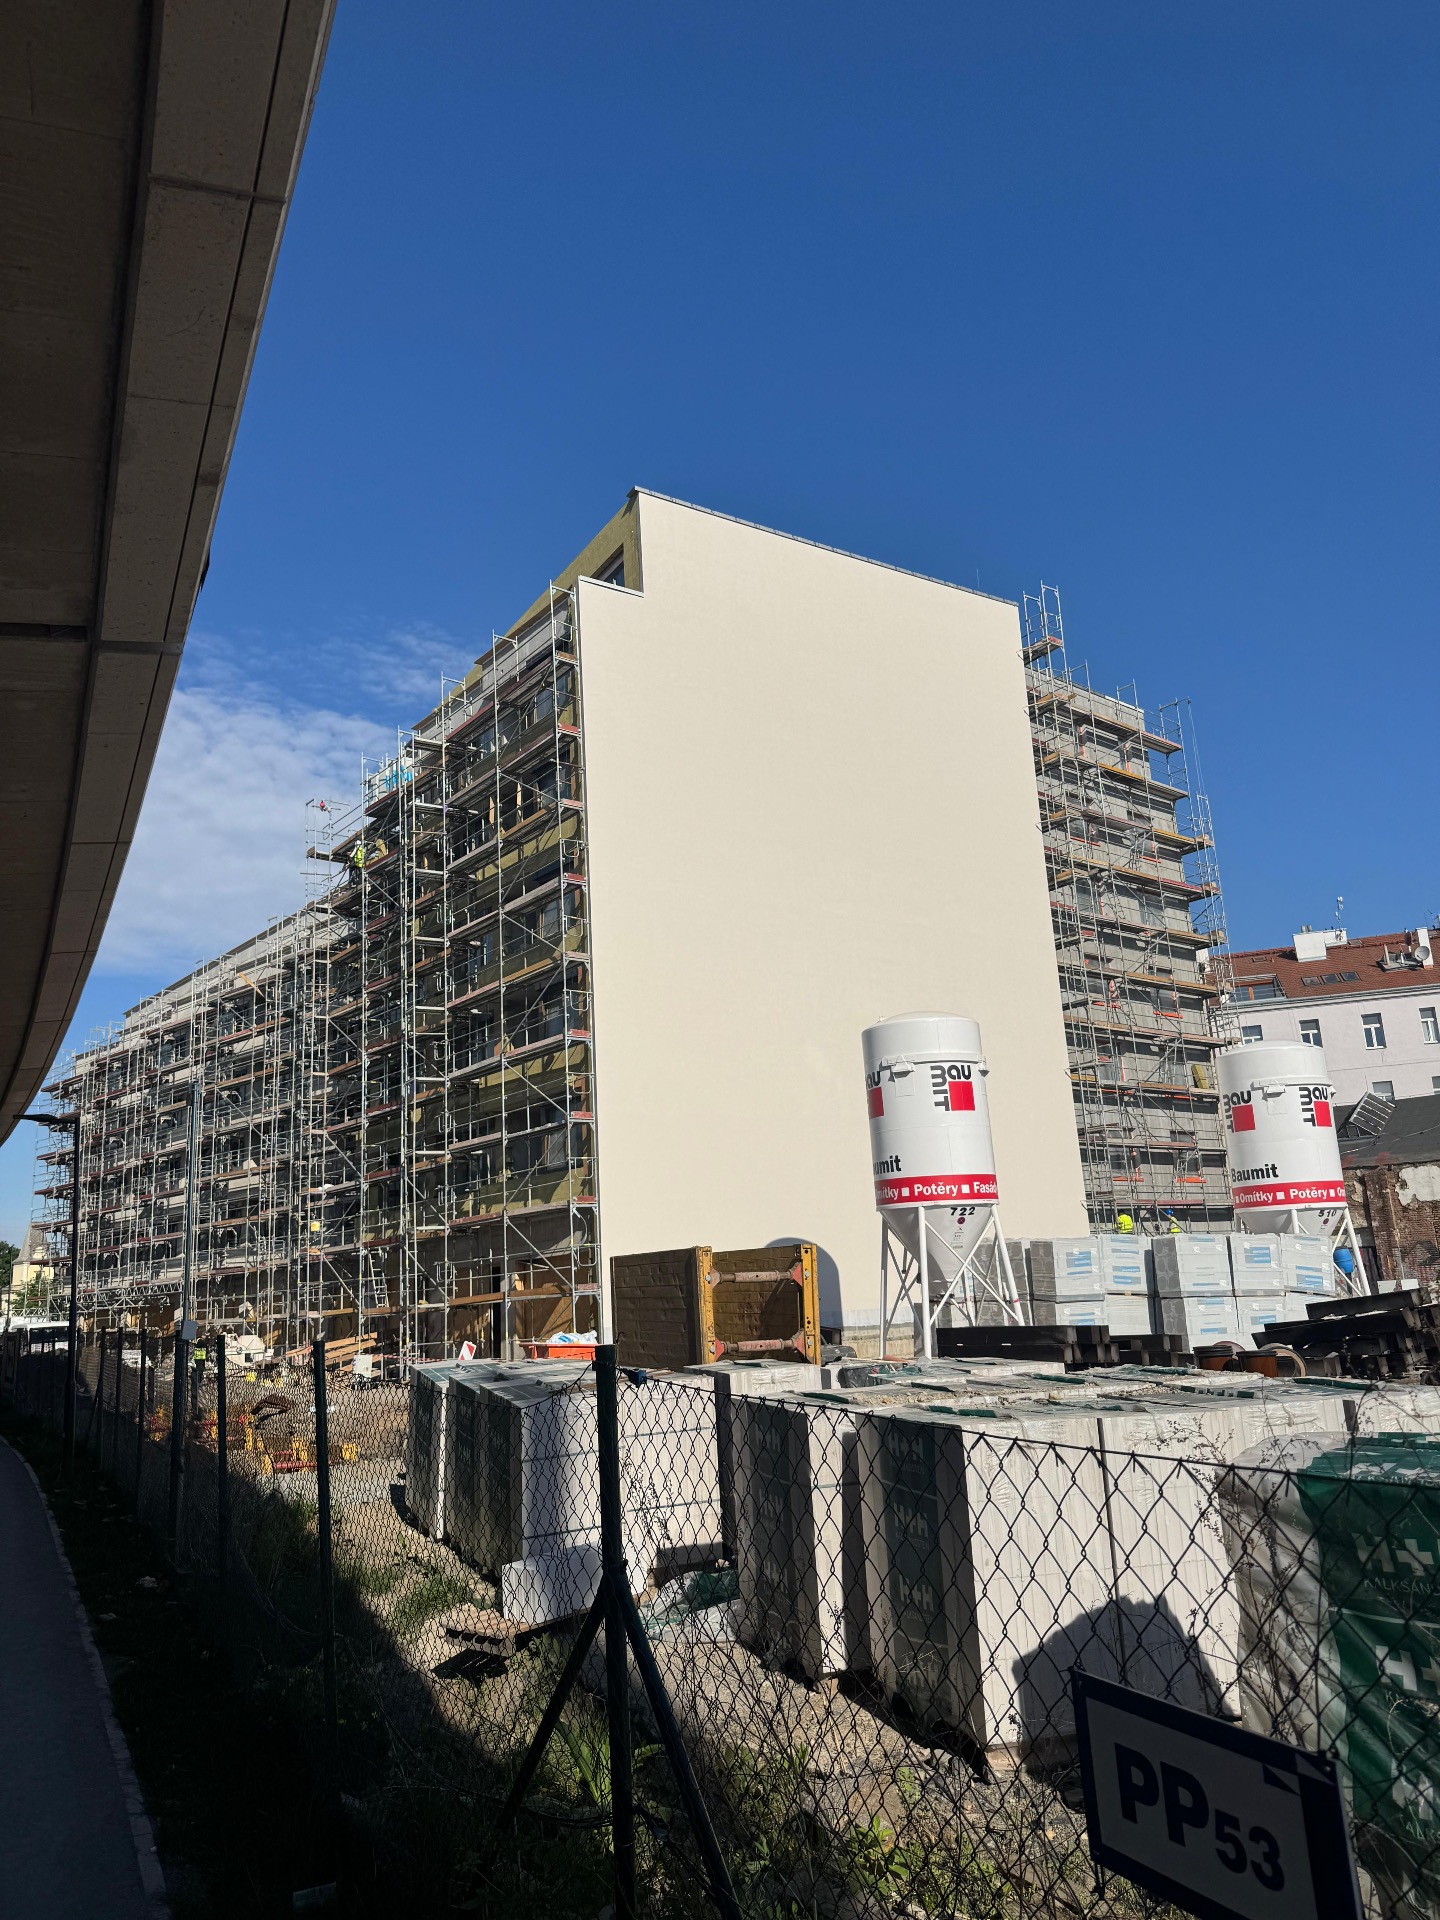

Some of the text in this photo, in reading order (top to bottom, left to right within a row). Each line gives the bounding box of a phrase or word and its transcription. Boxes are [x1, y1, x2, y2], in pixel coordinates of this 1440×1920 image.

[1231, 1163, 1279, 1182] Baumit
[914, 1182, 958, 1197] Potěry
[1240, 1190, 1273, 1203] Omítky
[1289, 1187, 1327, 1199] Potěry
[950, 1207, 976, 1216] 722
[1318, 1209, 1337, 1217] 510
